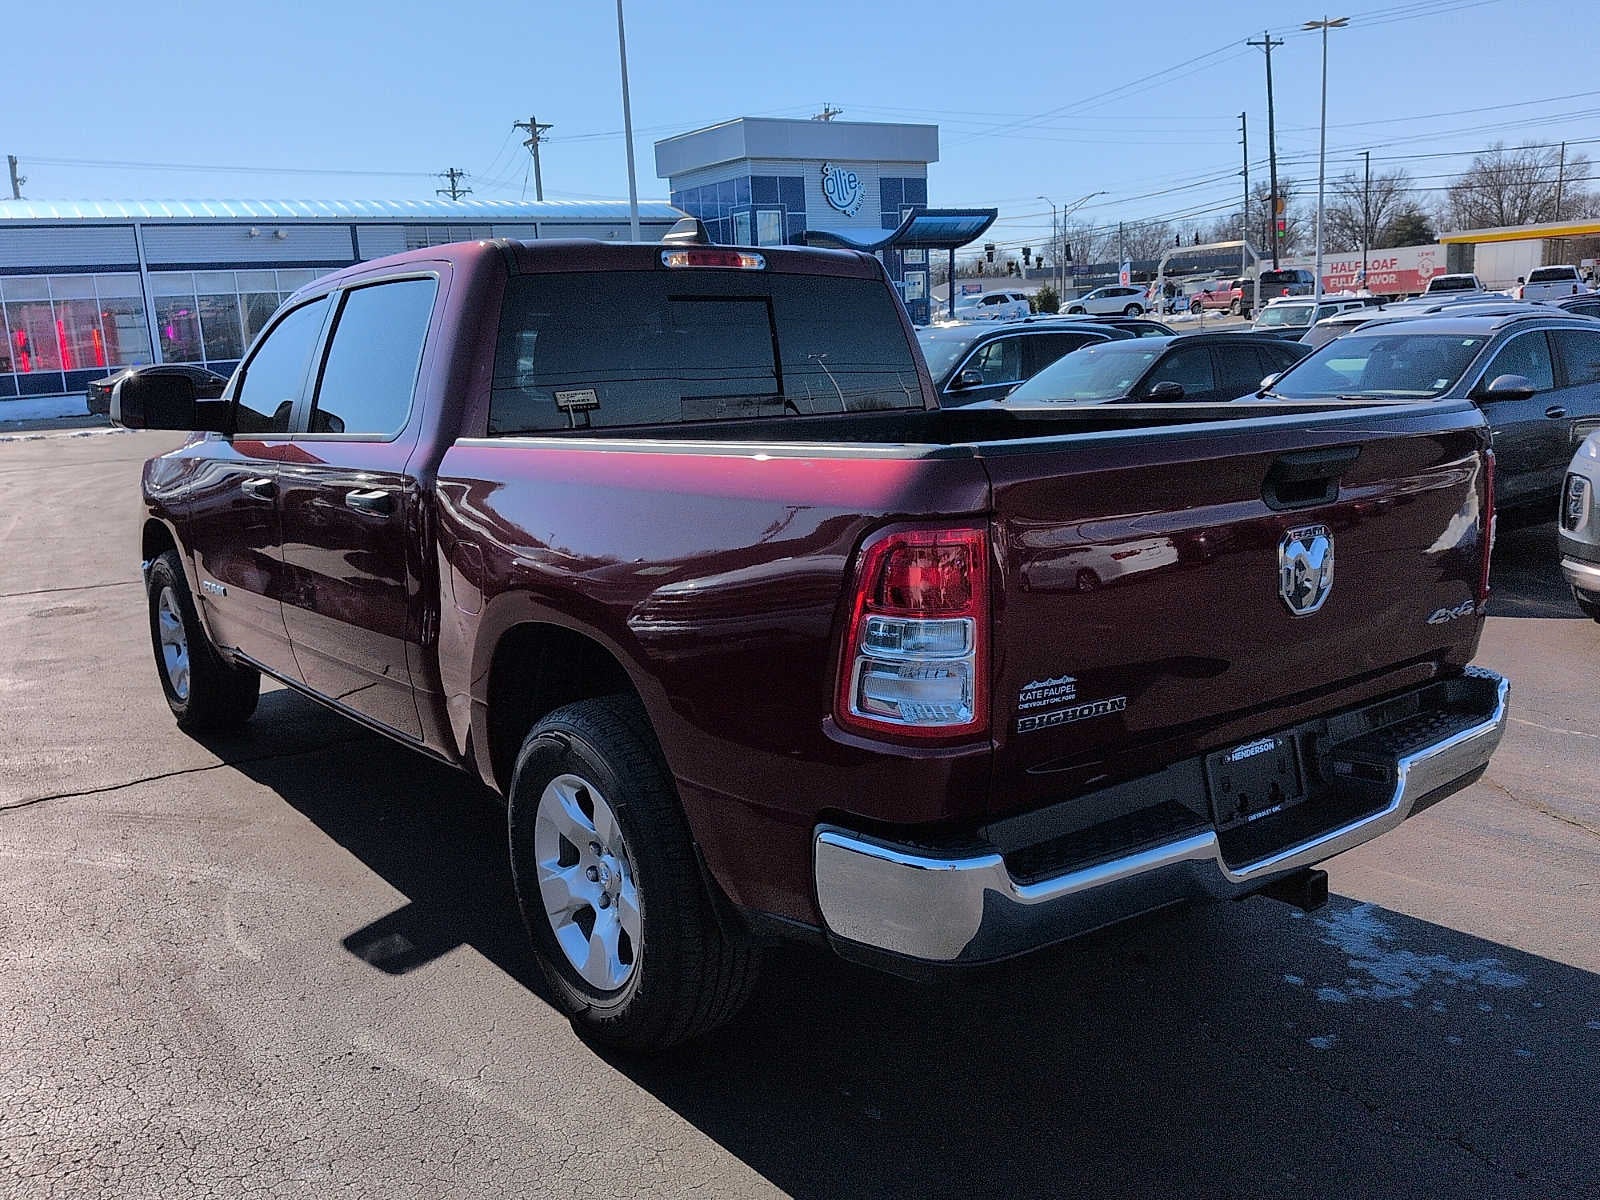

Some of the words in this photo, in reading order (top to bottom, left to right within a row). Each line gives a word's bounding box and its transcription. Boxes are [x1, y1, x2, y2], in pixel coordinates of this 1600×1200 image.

[1331, 261, 1362, 273] HALF
[1293, 527, 1325, 539] RAM
[1019, 690, 1042, 702] KATE
[1043, 684, 1076, 698] FAUPEL
[1018, 699, 1049, 710] CHEVROLET
[1018, 696, 1128, 734] BIGHORN
[1231, 742, 1275, 762] HENDERSON
